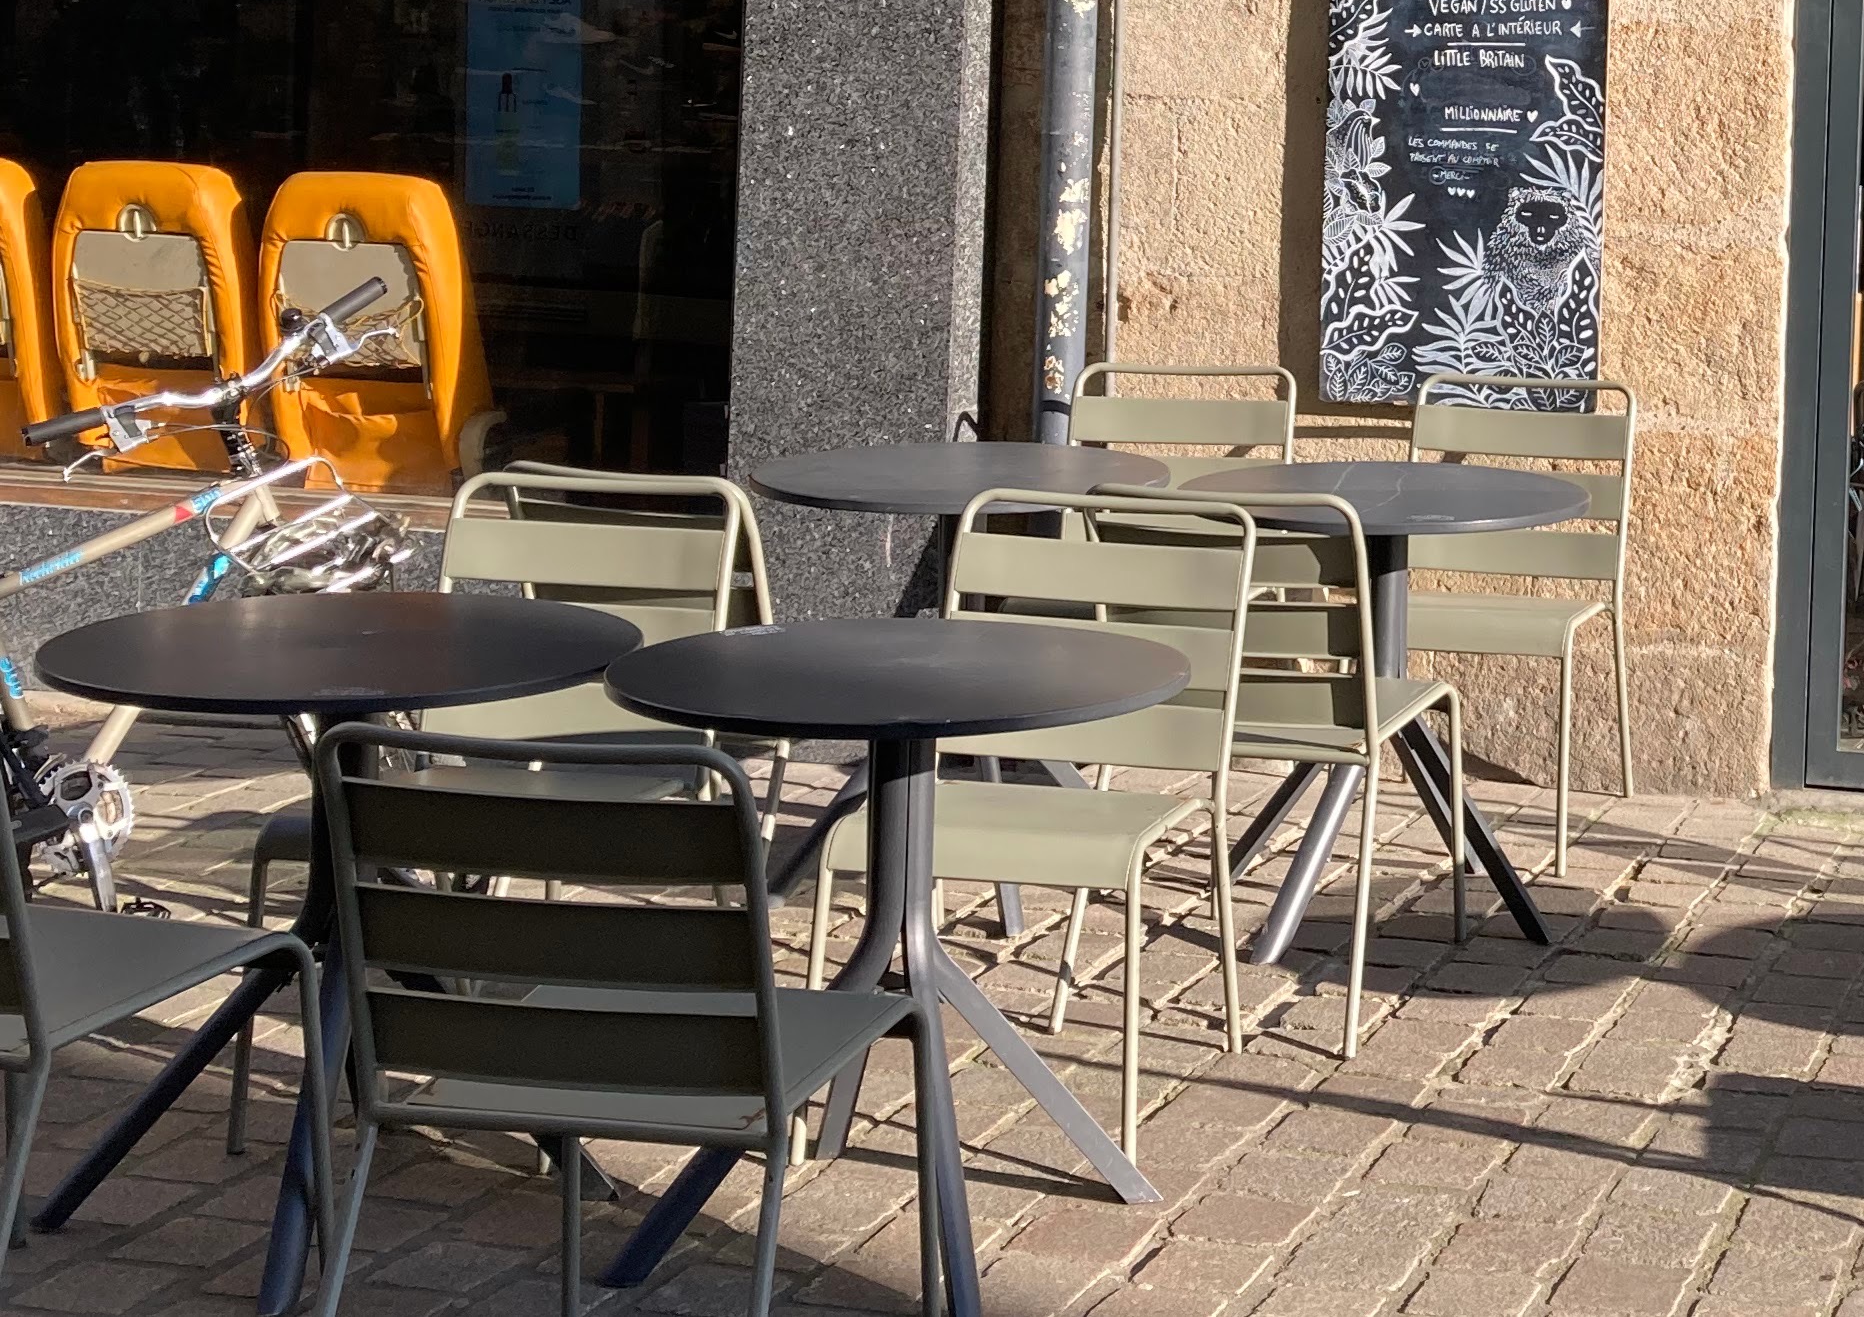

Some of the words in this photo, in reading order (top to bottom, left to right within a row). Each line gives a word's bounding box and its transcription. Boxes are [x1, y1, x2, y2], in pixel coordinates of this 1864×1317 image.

[1423, 22, 1464, 38] CARTE
[1486, 15, 1563, 37] L'INTÉRIEUR
[1433, 49, 1471, 67] LITTLE
[1478, 48, 1526, 69] BRITAIN
[1444, 104, 1524, 123] MILLIONNAIRE
[1408, 136, 1425, 148] LES
[1427, 138, 1478, 151] COMMANDES
